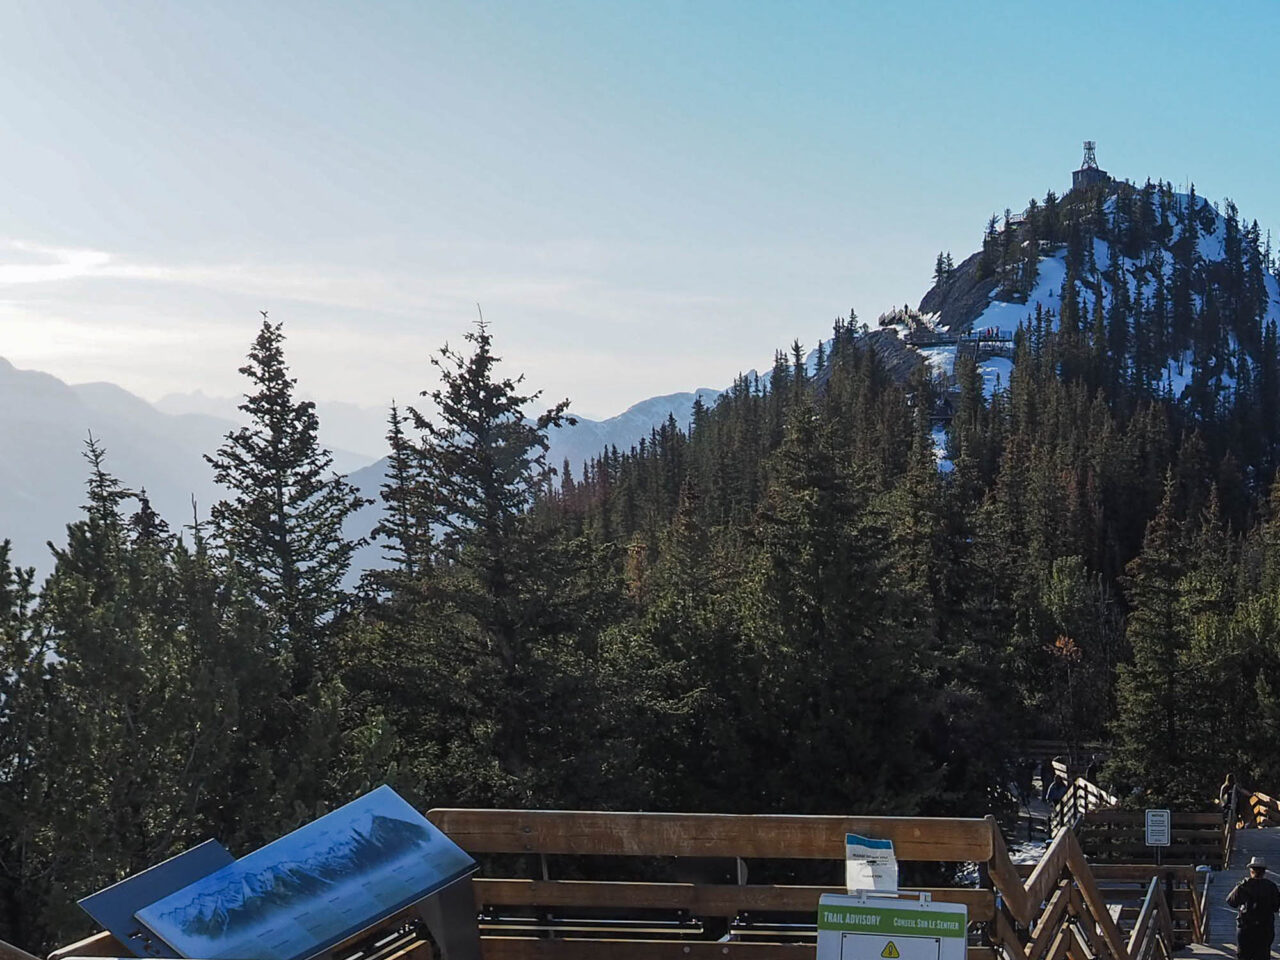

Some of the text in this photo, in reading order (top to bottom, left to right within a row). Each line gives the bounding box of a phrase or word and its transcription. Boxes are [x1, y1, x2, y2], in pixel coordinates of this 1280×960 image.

[824, 912, 881, 926] TRAIL ADVISORY
[894, 917, 959, 930] CONSEIL SUR LE SENTIER
